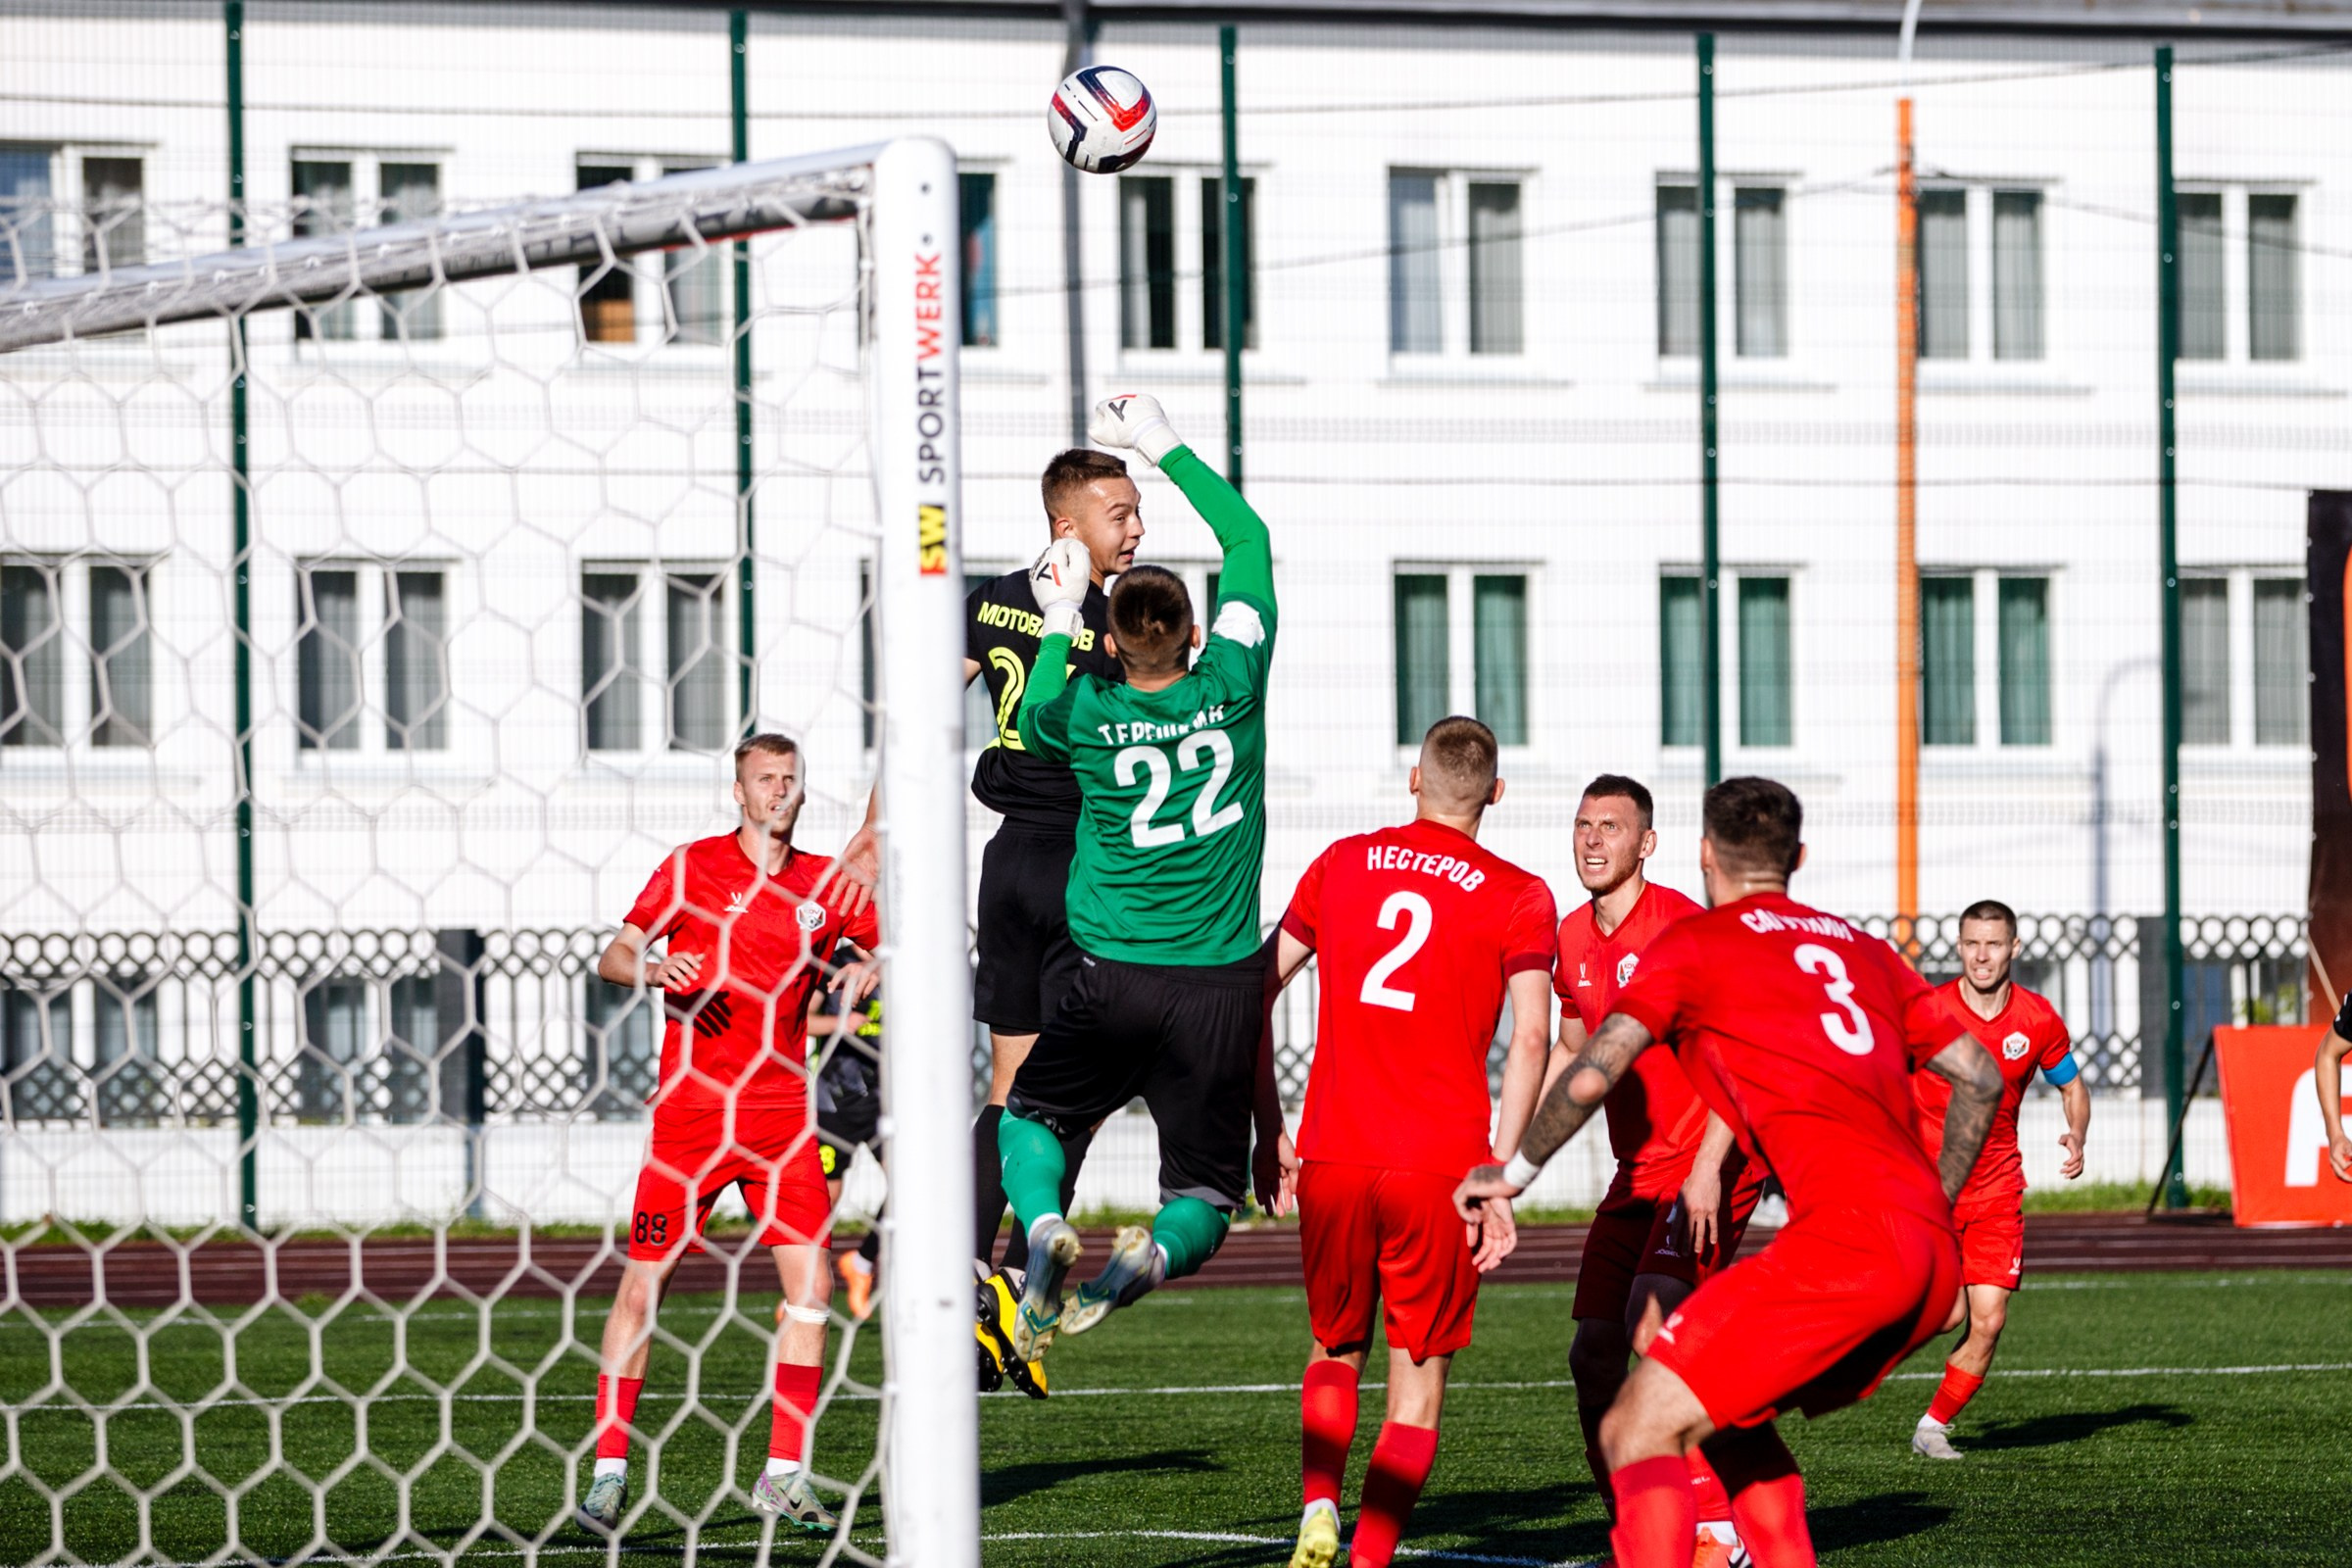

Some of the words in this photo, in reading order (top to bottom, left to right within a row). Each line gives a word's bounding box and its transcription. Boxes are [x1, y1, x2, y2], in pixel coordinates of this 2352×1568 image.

[915, 252, 946, 484] SPORTWERK
[920, 504, 948, 574] SW
[1114, 728, 1245, 848] 22
[1367, 845, 1486, 893] НЕСТЕРОВ
[1359, 890, 1433, 1012] 2
[1792, 943, 1876, 1056] 3
[635, 1210, 667, 1247] 88
